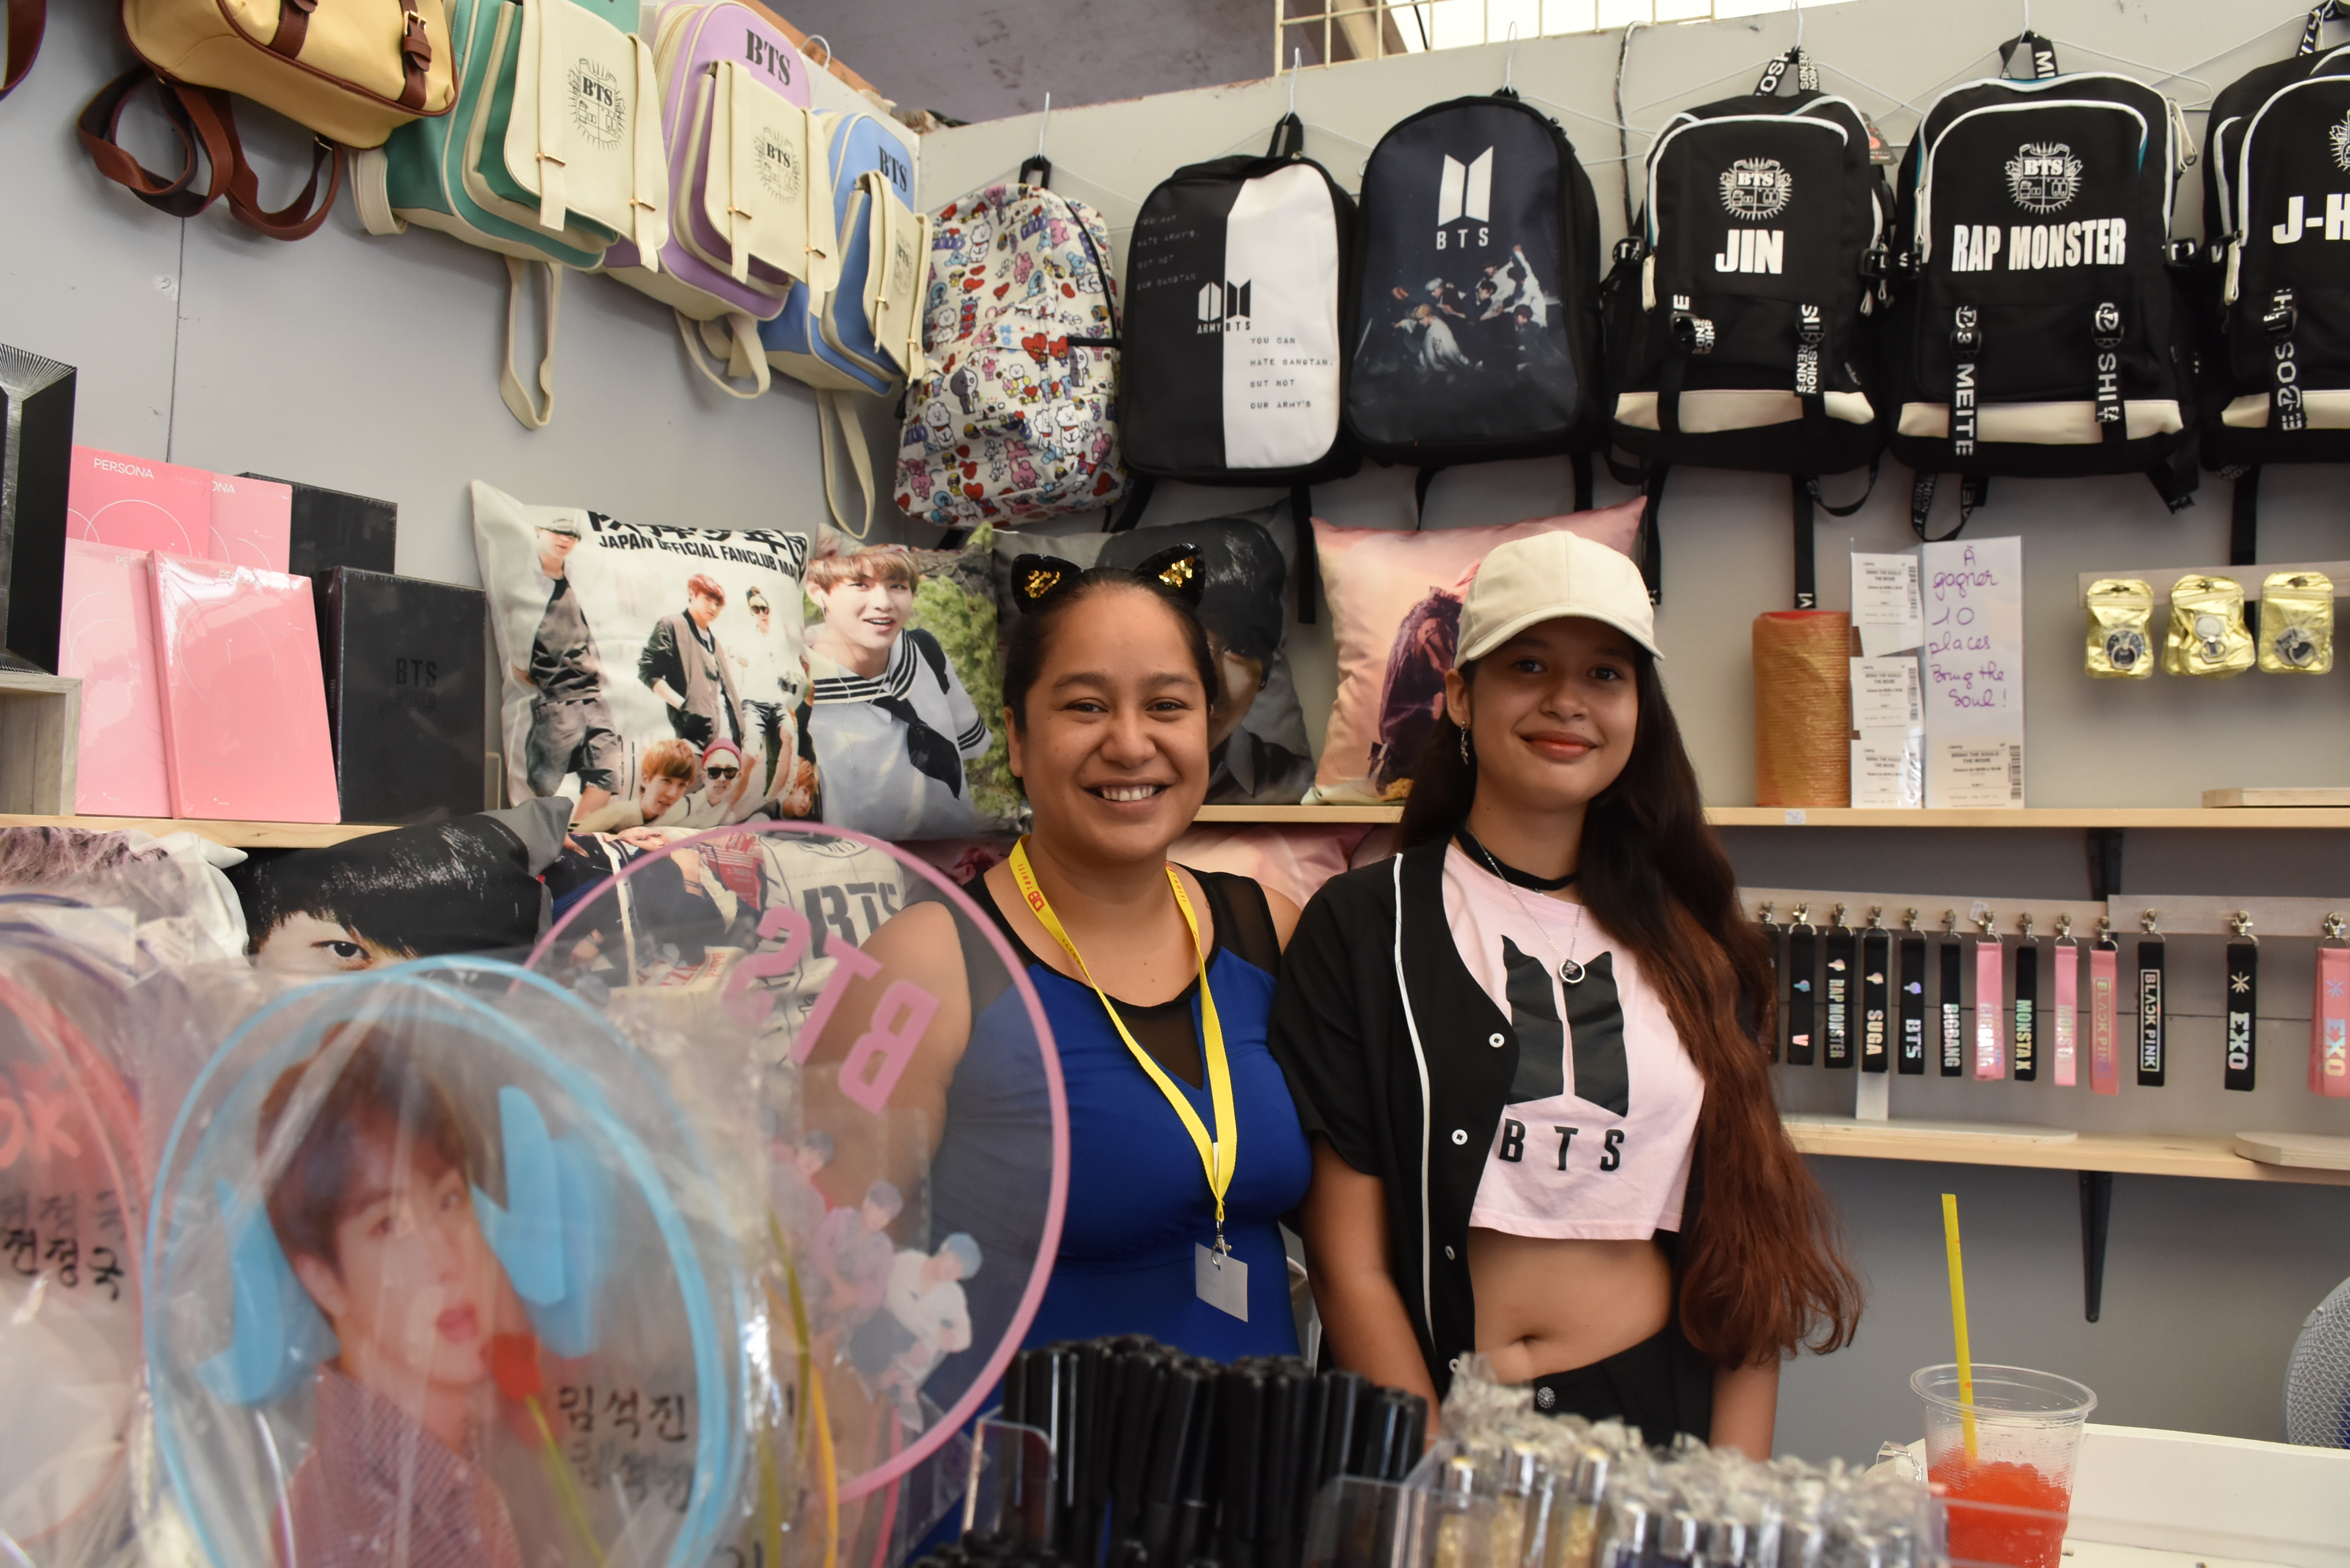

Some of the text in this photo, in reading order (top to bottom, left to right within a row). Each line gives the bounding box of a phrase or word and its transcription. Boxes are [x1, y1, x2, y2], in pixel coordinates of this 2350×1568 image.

[745, 29, 791, 86] BTS
[582, 76, 613, 106] BTS
[766, 142, 791, 168] BTS
[879, 145, 907, 192] BTS
[2024, 159, 2064, 176] BTS
[1737, 172, 1775, 187] BTS
[1436, 227, 1489, 250] BTS
[1715, 229, 1784, 274] JIN
[1951, 217, 2127, 272] RAP MONSTER
[1196, 323, 1222, 335] ARMY
[1225, 321, 1251, 332] BTS
[1250, 358, 1275, 366] HATE
[1250, 379, 1296, 388] BUT NOT
[1955, 363, 1975, 456] MEITE
[94, 457, 154, 479] PERSONA
[599, 532, 654, 550] JAPAN
[721, 545, 778, 571] FANCLUB
[1933, 570, 1999, 602] gagner
[1932, 607, 1975, 626] 10
[1929, 631, 1991, 660] places
[395, 657, 437, 688] BTS
[1930, 660, 2005, 690] Bring the
[1017, 863, 1034, 891] TAHITI
[1172, 874, 1187, 902] TAHITI
[1828, 979, 1846, 1058] RAP MONSTER
[1865, 1009, 1884, 1056] SUGA
[1792, 1034, 1810, 1047] V
[1905, 1019, 1922, 1059] BTS
[1943, 1003, 1961, 1067] BIGBANG
[1977, 1002, 1994, 1067] BIGBANG
[2015, 999, 2032, 1071] MONSTA X
[2228, 1011, 2250, 1070] EXO
[2325, 1017, 2346, 1077] EXO
[1498, 1118, 1625, 1171] BTS
